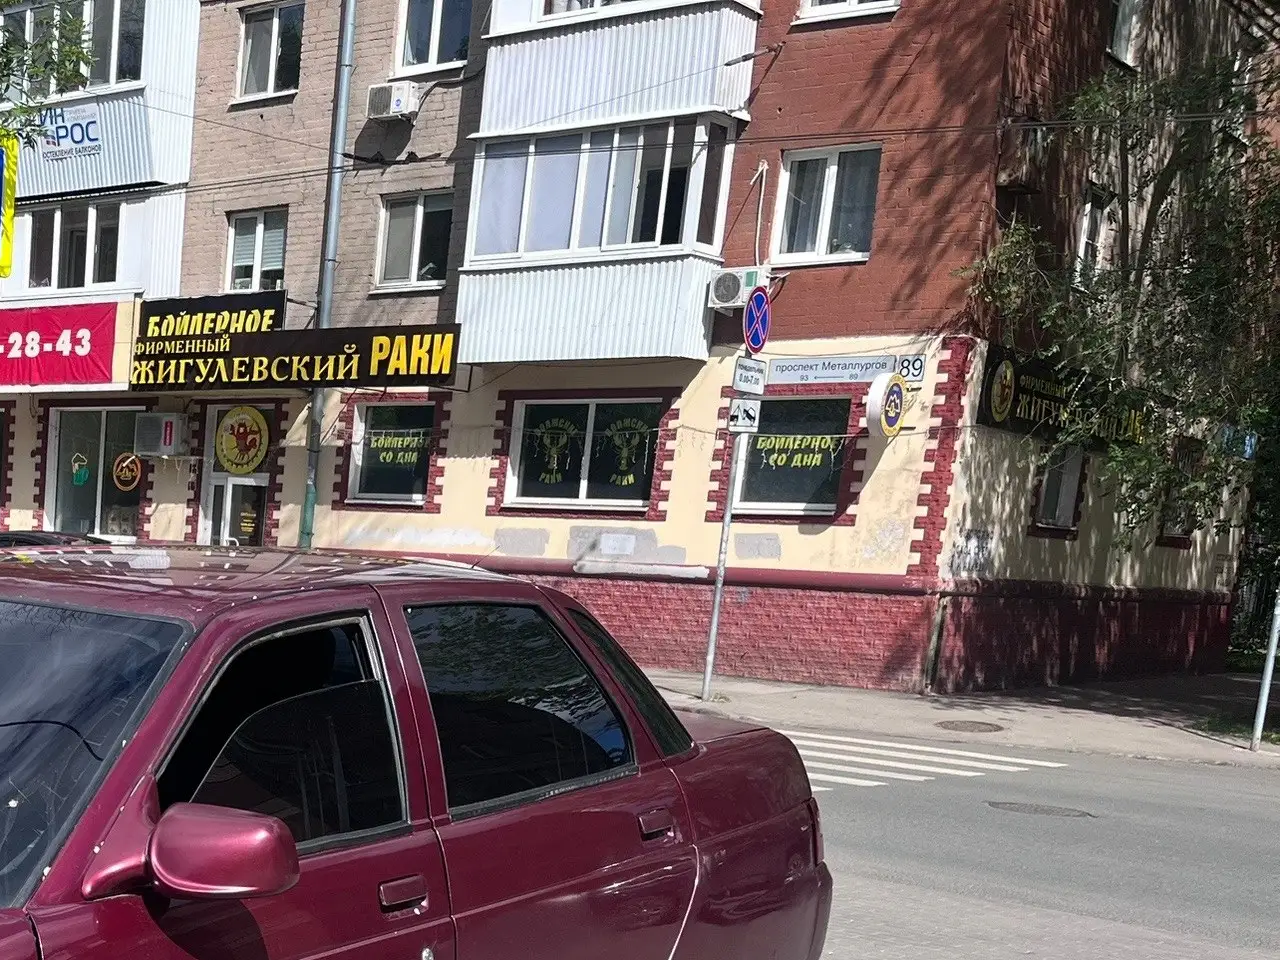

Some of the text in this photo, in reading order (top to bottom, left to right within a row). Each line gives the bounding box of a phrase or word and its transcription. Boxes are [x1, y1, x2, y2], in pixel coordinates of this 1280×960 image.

[55, 120, 99, 147] РОС
[147, 309, 276, 337] БОЙЛЕРНОЕ
[135, 334, 231, 355] ФИРМЕННЫЙ
[130, 332, 455, 385] ЖИГУЛЕВСКИЙ РАКИ
[775, 361, 887, 373] проспект Металлургов
[899, 357, 923, 378] 89
[380, 451, 418, 464] СО ДНА
[769, 452, 823, 468] СО ДНА
